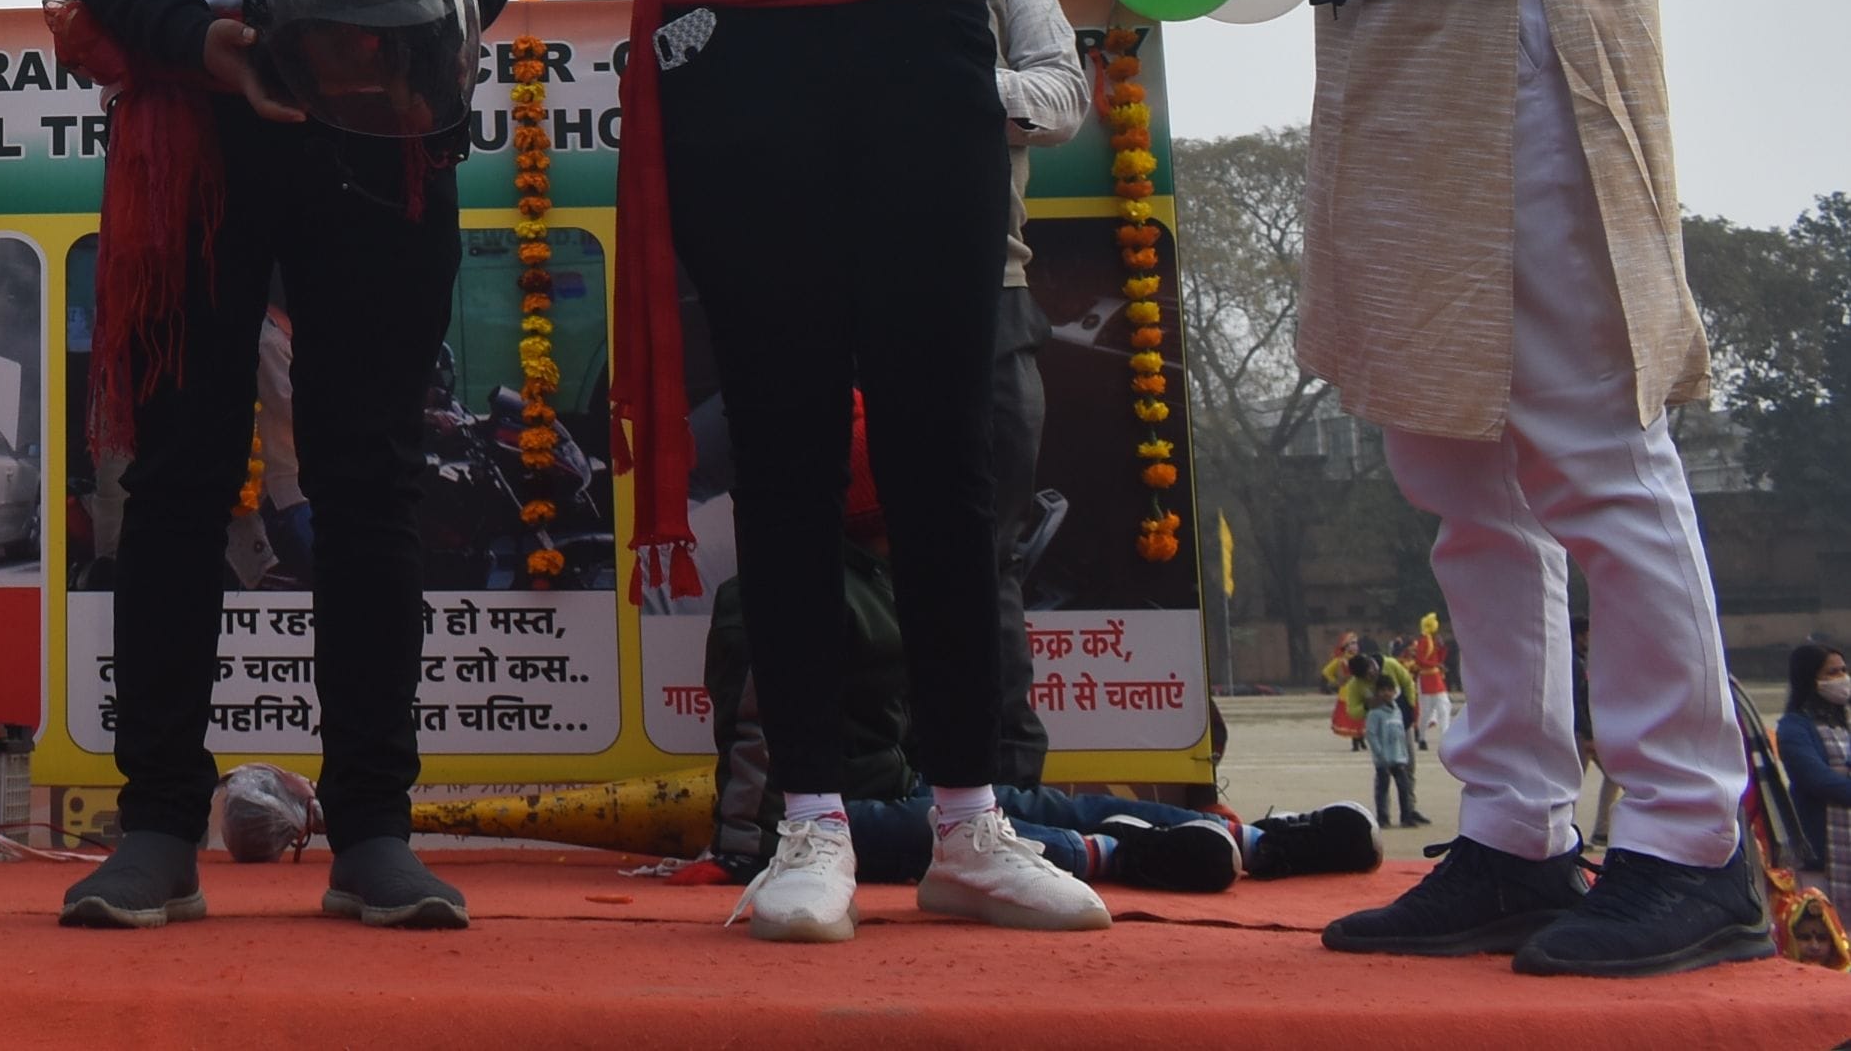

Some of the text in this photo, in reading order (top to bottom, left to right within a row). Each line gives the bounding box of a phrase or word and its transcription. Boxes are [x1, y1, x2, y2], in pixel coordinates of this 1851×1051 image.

[444, 599, 480, 635] हो
[453, 647, 499, 683] लो
[1072, 672, 1098, 711] से
